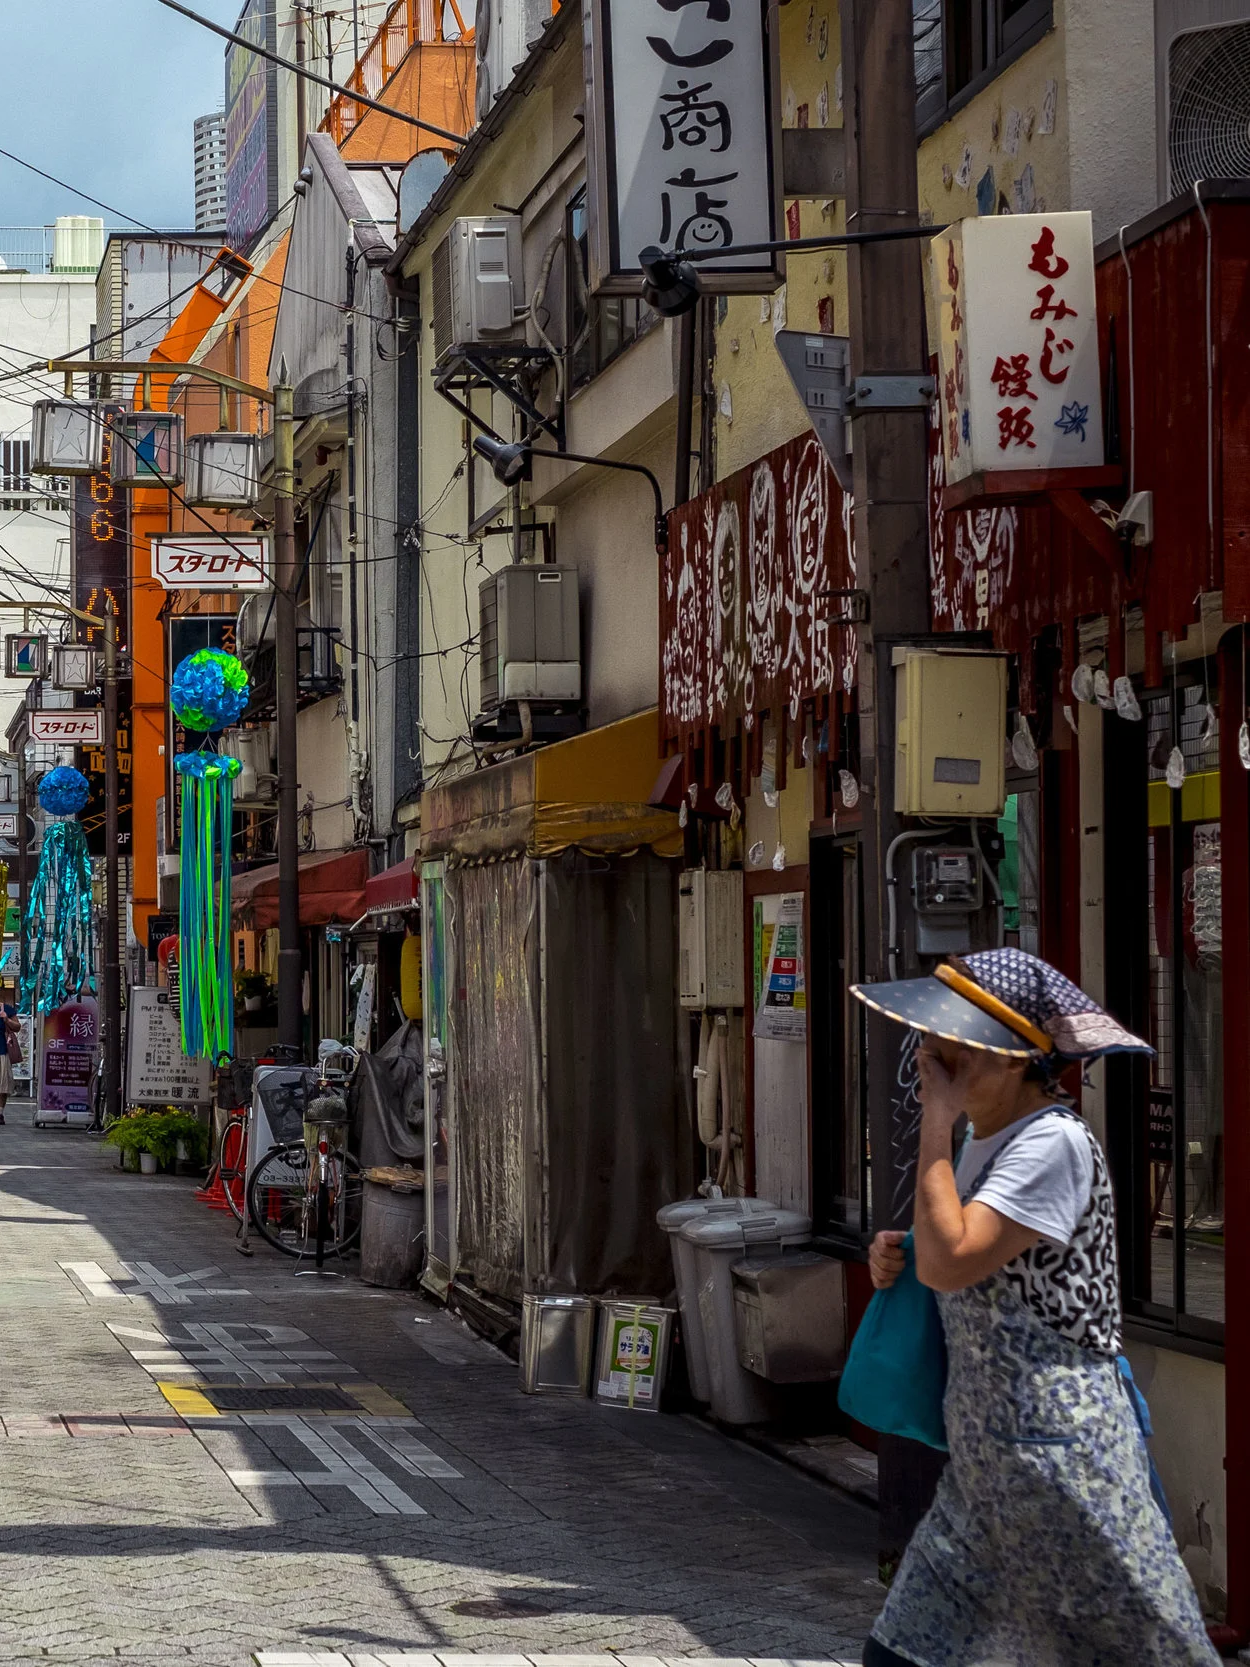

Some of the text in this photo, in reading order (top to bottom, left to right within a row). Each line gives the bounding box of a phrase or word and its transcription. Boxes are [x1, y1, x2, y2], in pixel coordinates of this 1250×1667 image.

[1028, 226, 1078, 385] もみじ
[168, 554, 259, 574] スターロード
[38, 719, 96, 734] スターロード
[70, 1013, 94, 1037] 縁
[48, 1039, 64, 1049] 3F
